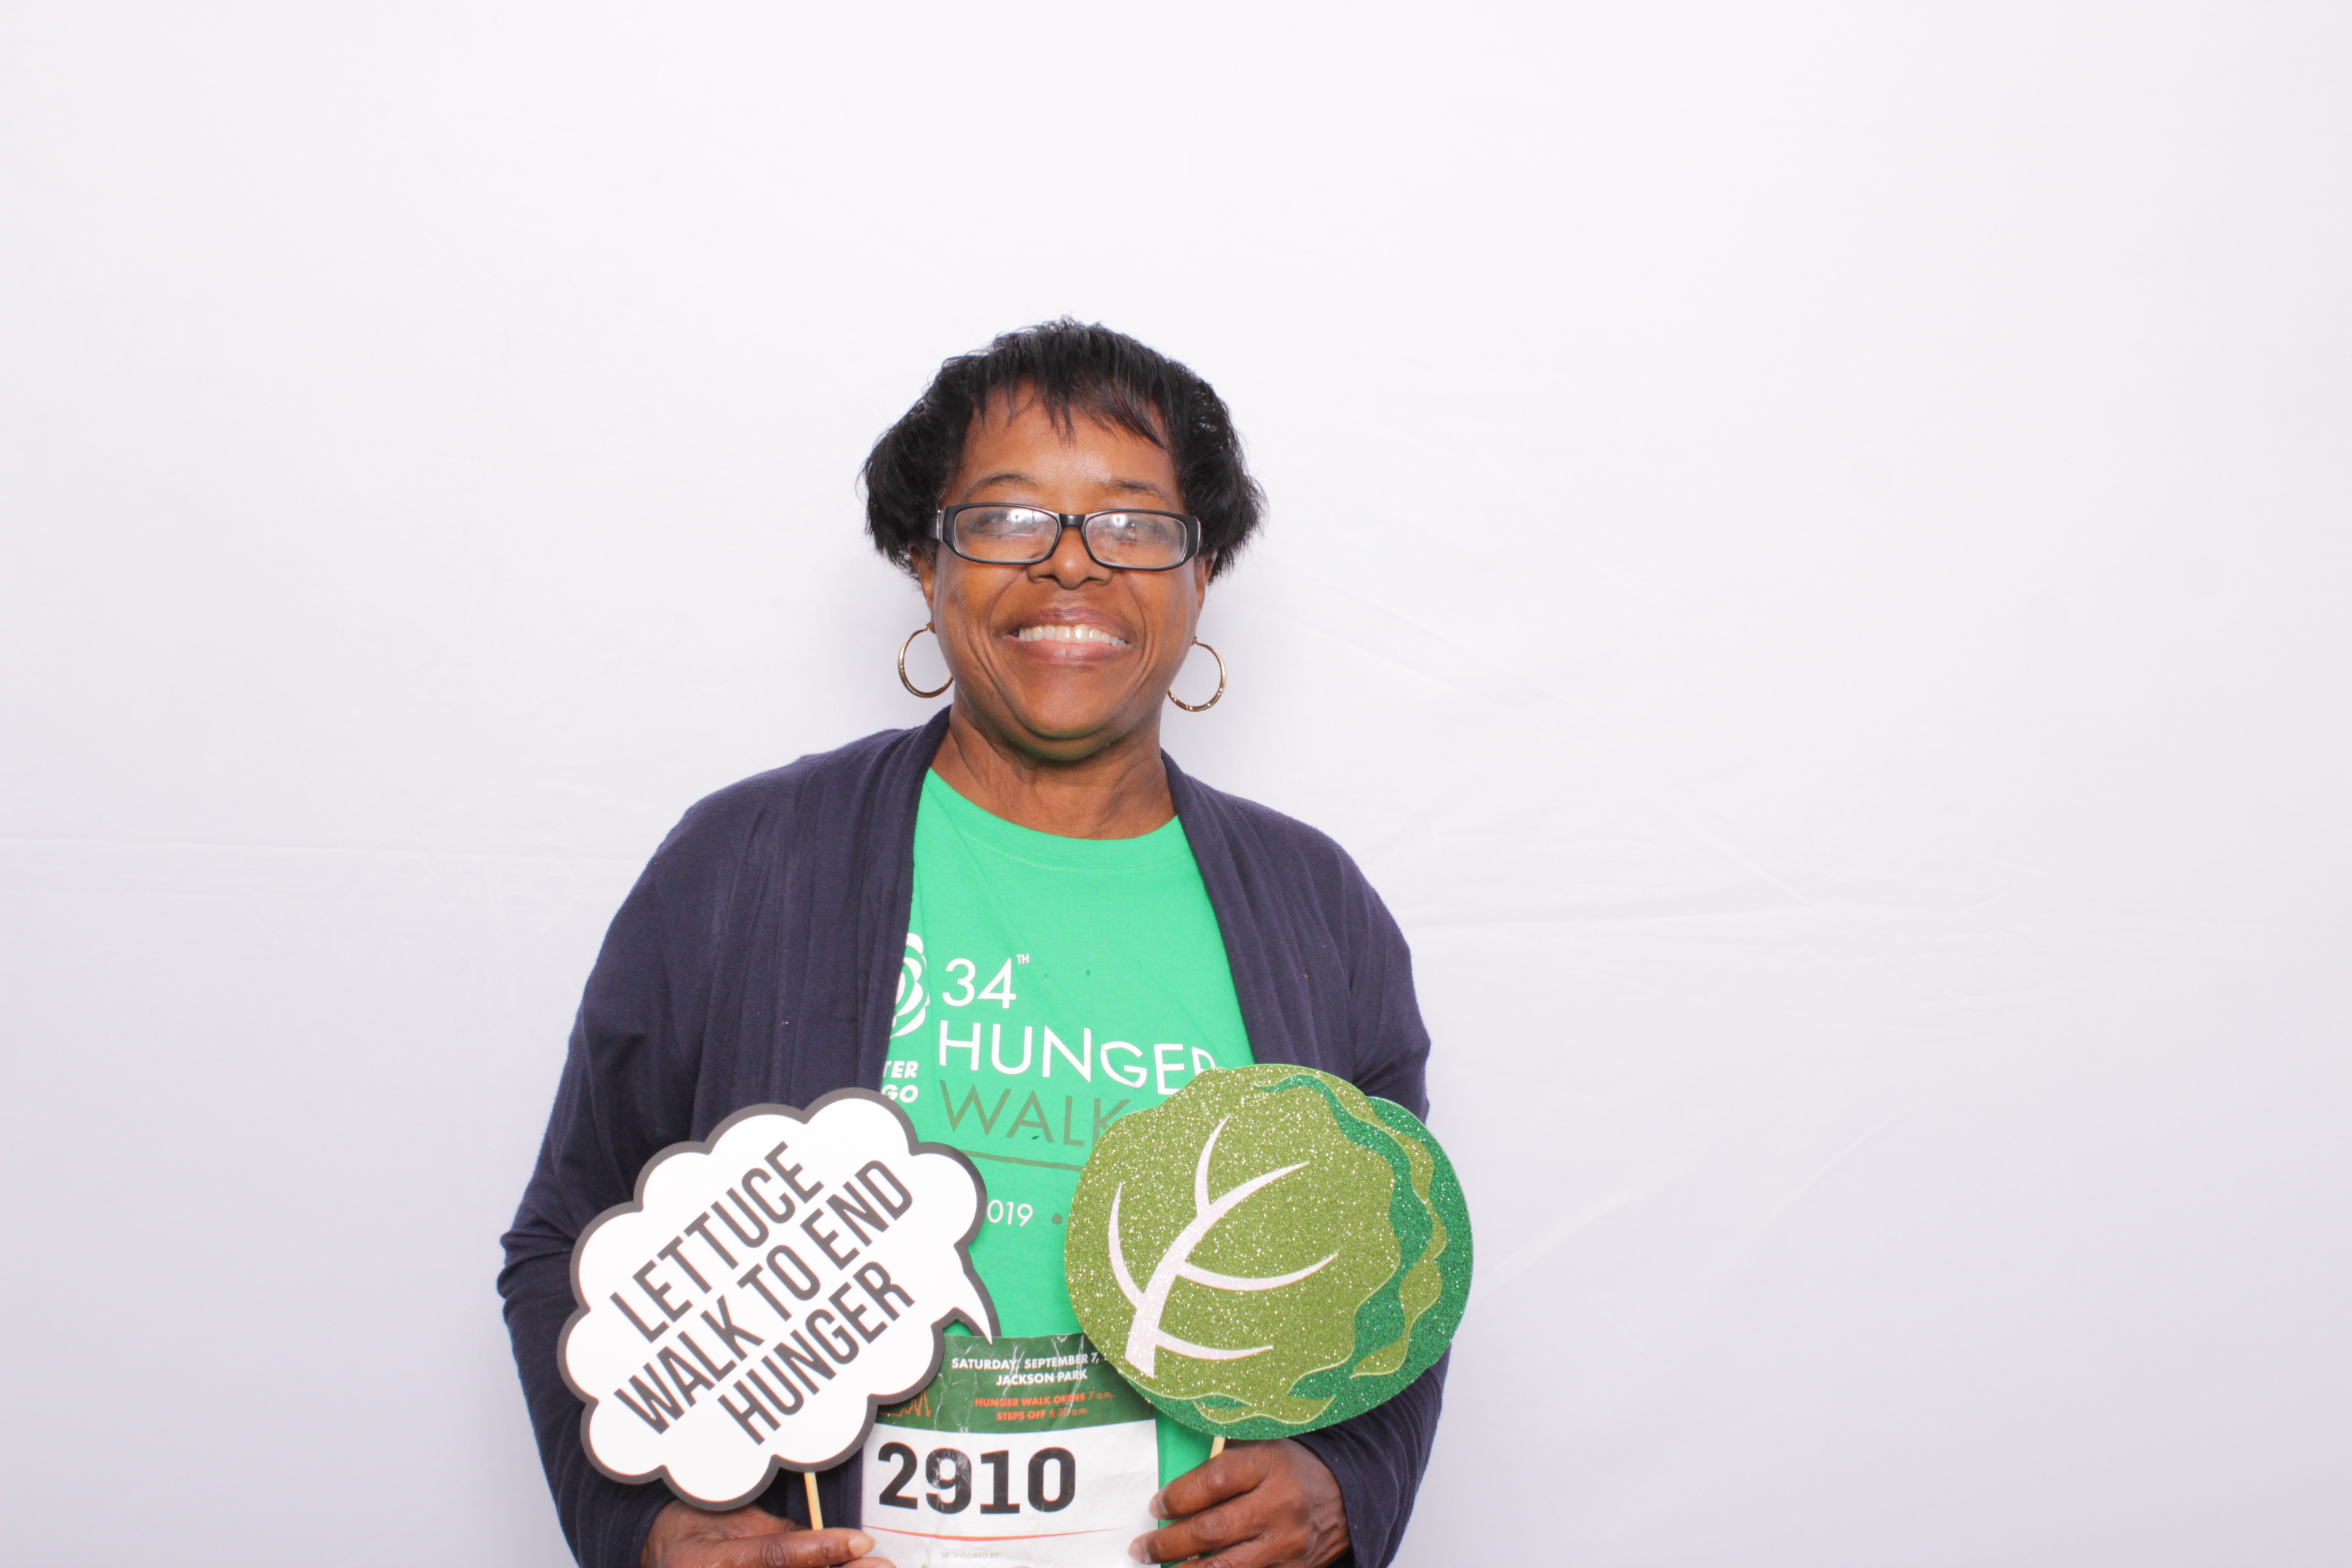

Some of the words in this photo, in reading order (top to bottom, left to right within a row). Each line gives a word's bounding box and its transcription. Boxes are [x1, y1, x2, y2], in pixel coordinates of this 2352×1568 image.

[942, 958, 1017, 1009] 34
[939, 1079, 1131, 1148] WALK
[987, 1199, 1034, 1227] 019
[609, 1141, 824, 1343] LETTUCE
[613, 1294, 765, 1434] WALK
[736, 1245, 821, 1321] TO
[800, 1160, 913, 1270] END
[717, 1261, 916, 1446] HUNGER
[1024, 1354, 1088, 1369] SEPTEMBER
[1091, 1352, 1099, 1364] 7,
[996, 1374, 1054, 1386] JACKSON
[1058, 1369, 1088, 1382] PARK
[975, 1398, 1019, 1407] HUNGER
[1021, 1396, 1051, 1406] WALK
[1053, 1393, 1085, 1404] OPENS
[1088, 1391, 1094, 1400] 7
[996, 1411, 1025, 1421] STEPS
[1027, 1410, 1046, 1420] OFF
[1049, 1407, 1068, 1418] 8:30
[878, 1442, 1076, 1514] 2910
[941, 1551, 988, 1559] SPONSORED
